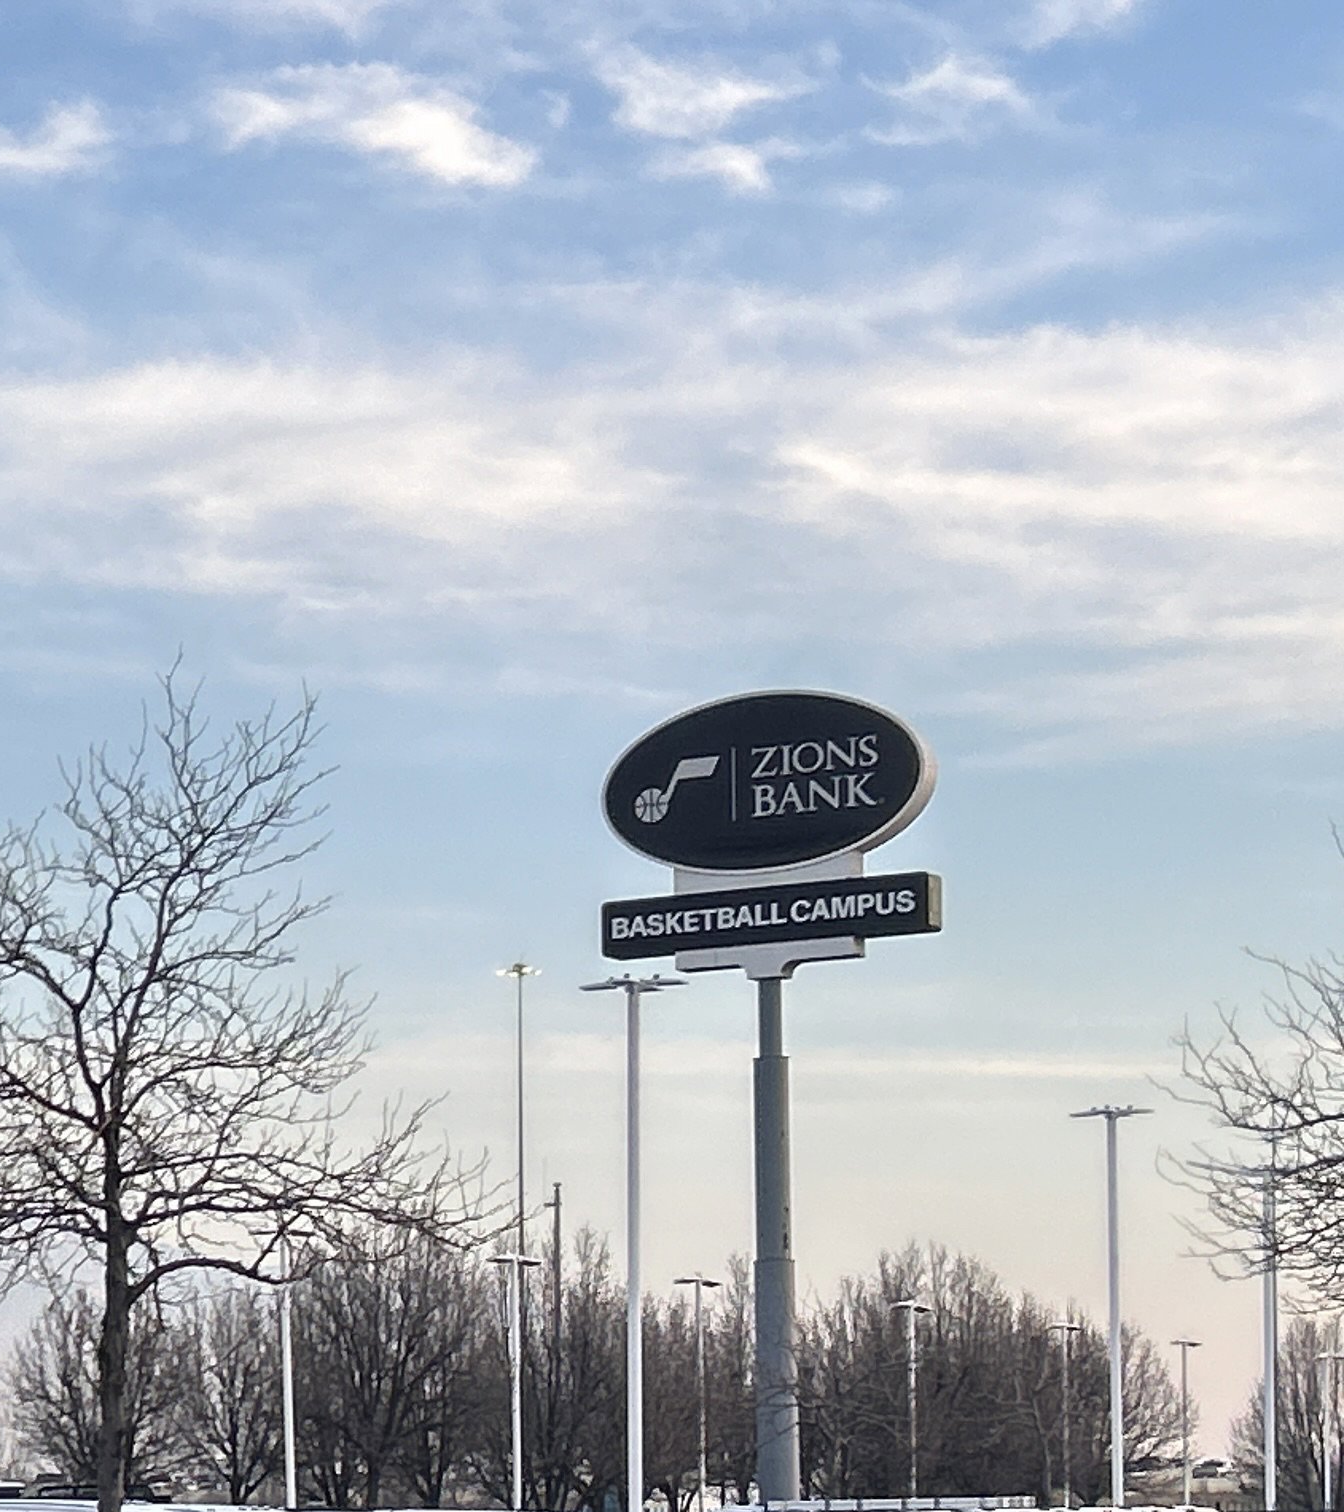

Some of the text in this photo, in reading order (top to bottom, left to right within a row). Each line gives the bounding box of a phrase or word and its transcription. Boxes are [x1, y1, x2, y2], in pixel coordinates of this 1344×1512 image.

[751, 734, 879, 779] ZIONS
[751, 772, 878, 818] BANK
[611, 889, 916, 940] BASKETBALL CAMPUS
